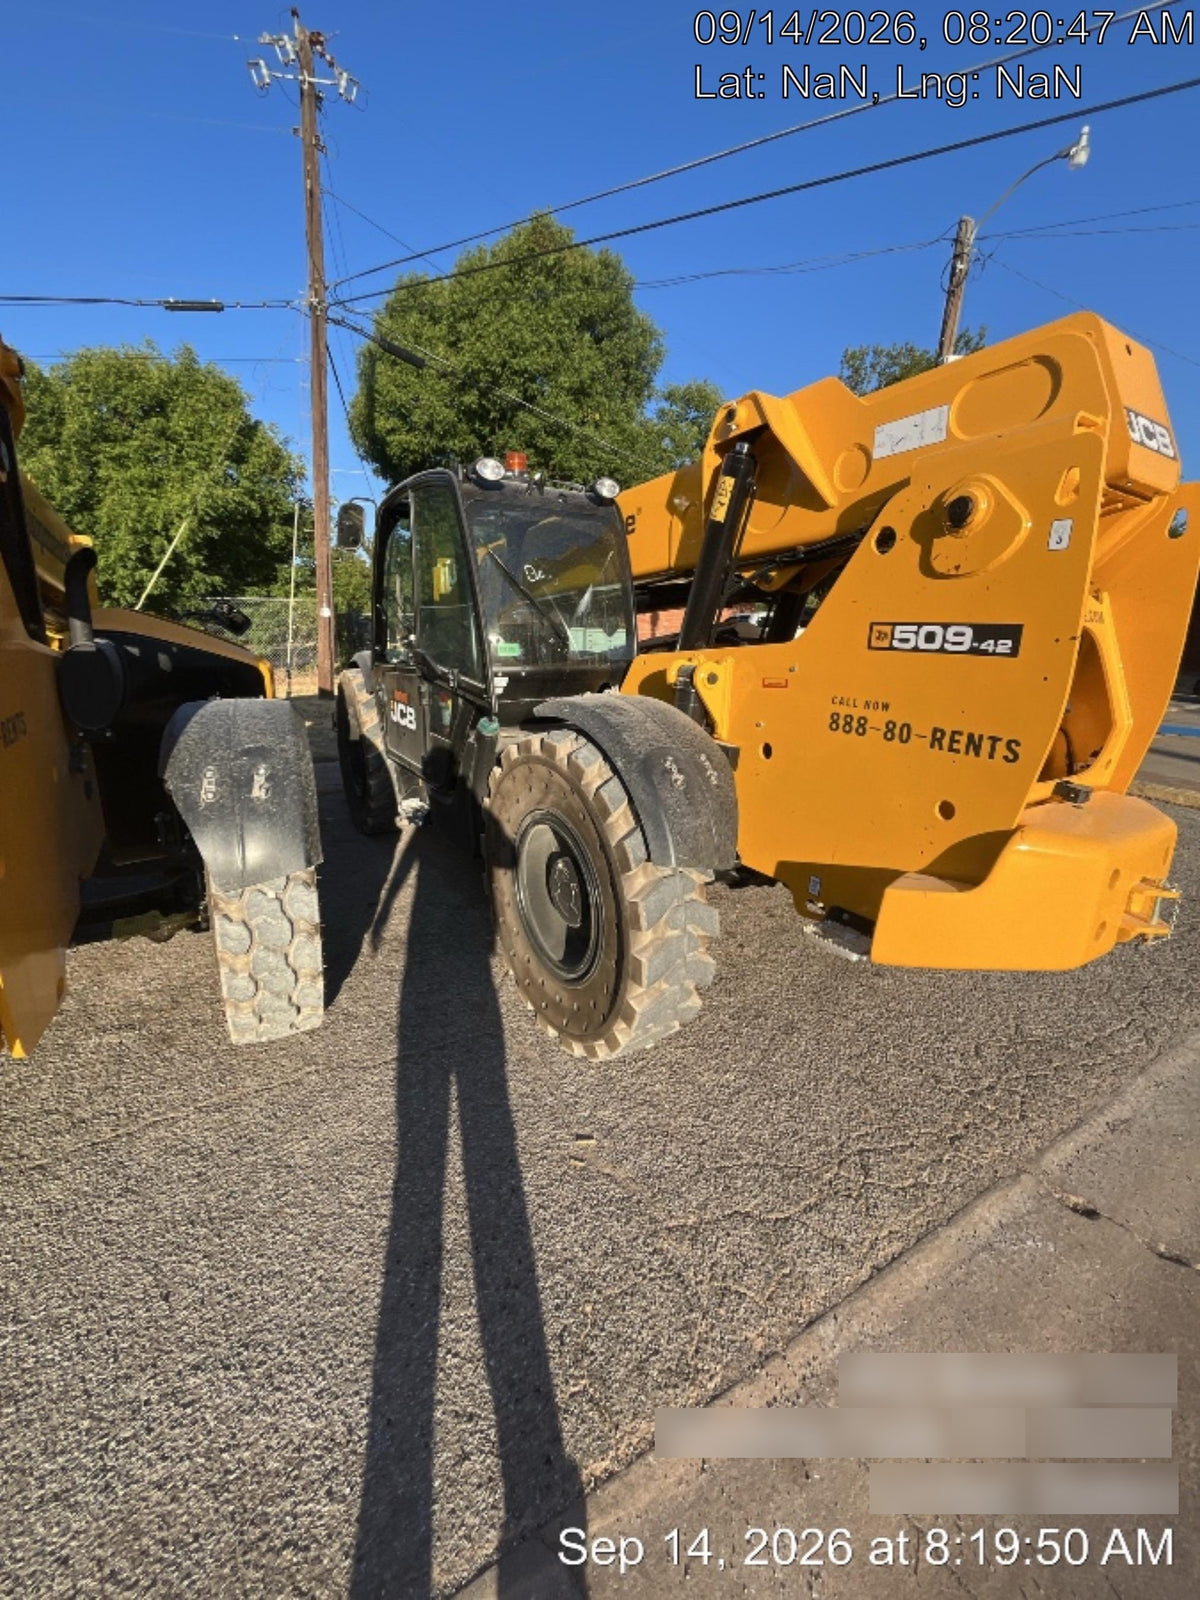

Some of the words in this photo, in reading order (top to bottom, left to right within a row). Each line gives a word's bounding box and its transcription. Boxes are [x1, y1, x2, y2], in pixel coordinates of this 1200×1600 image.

[1128, 411, 1174, 458] JCB
[892, 625, 1012, 653] 509-42
[390, 700, 417, 730] JCB
[831, 696, 858, 708] CALL
[863, 700, 890, 712] NOW
[828, 712, 1021, 763] 888-80-RENTS
